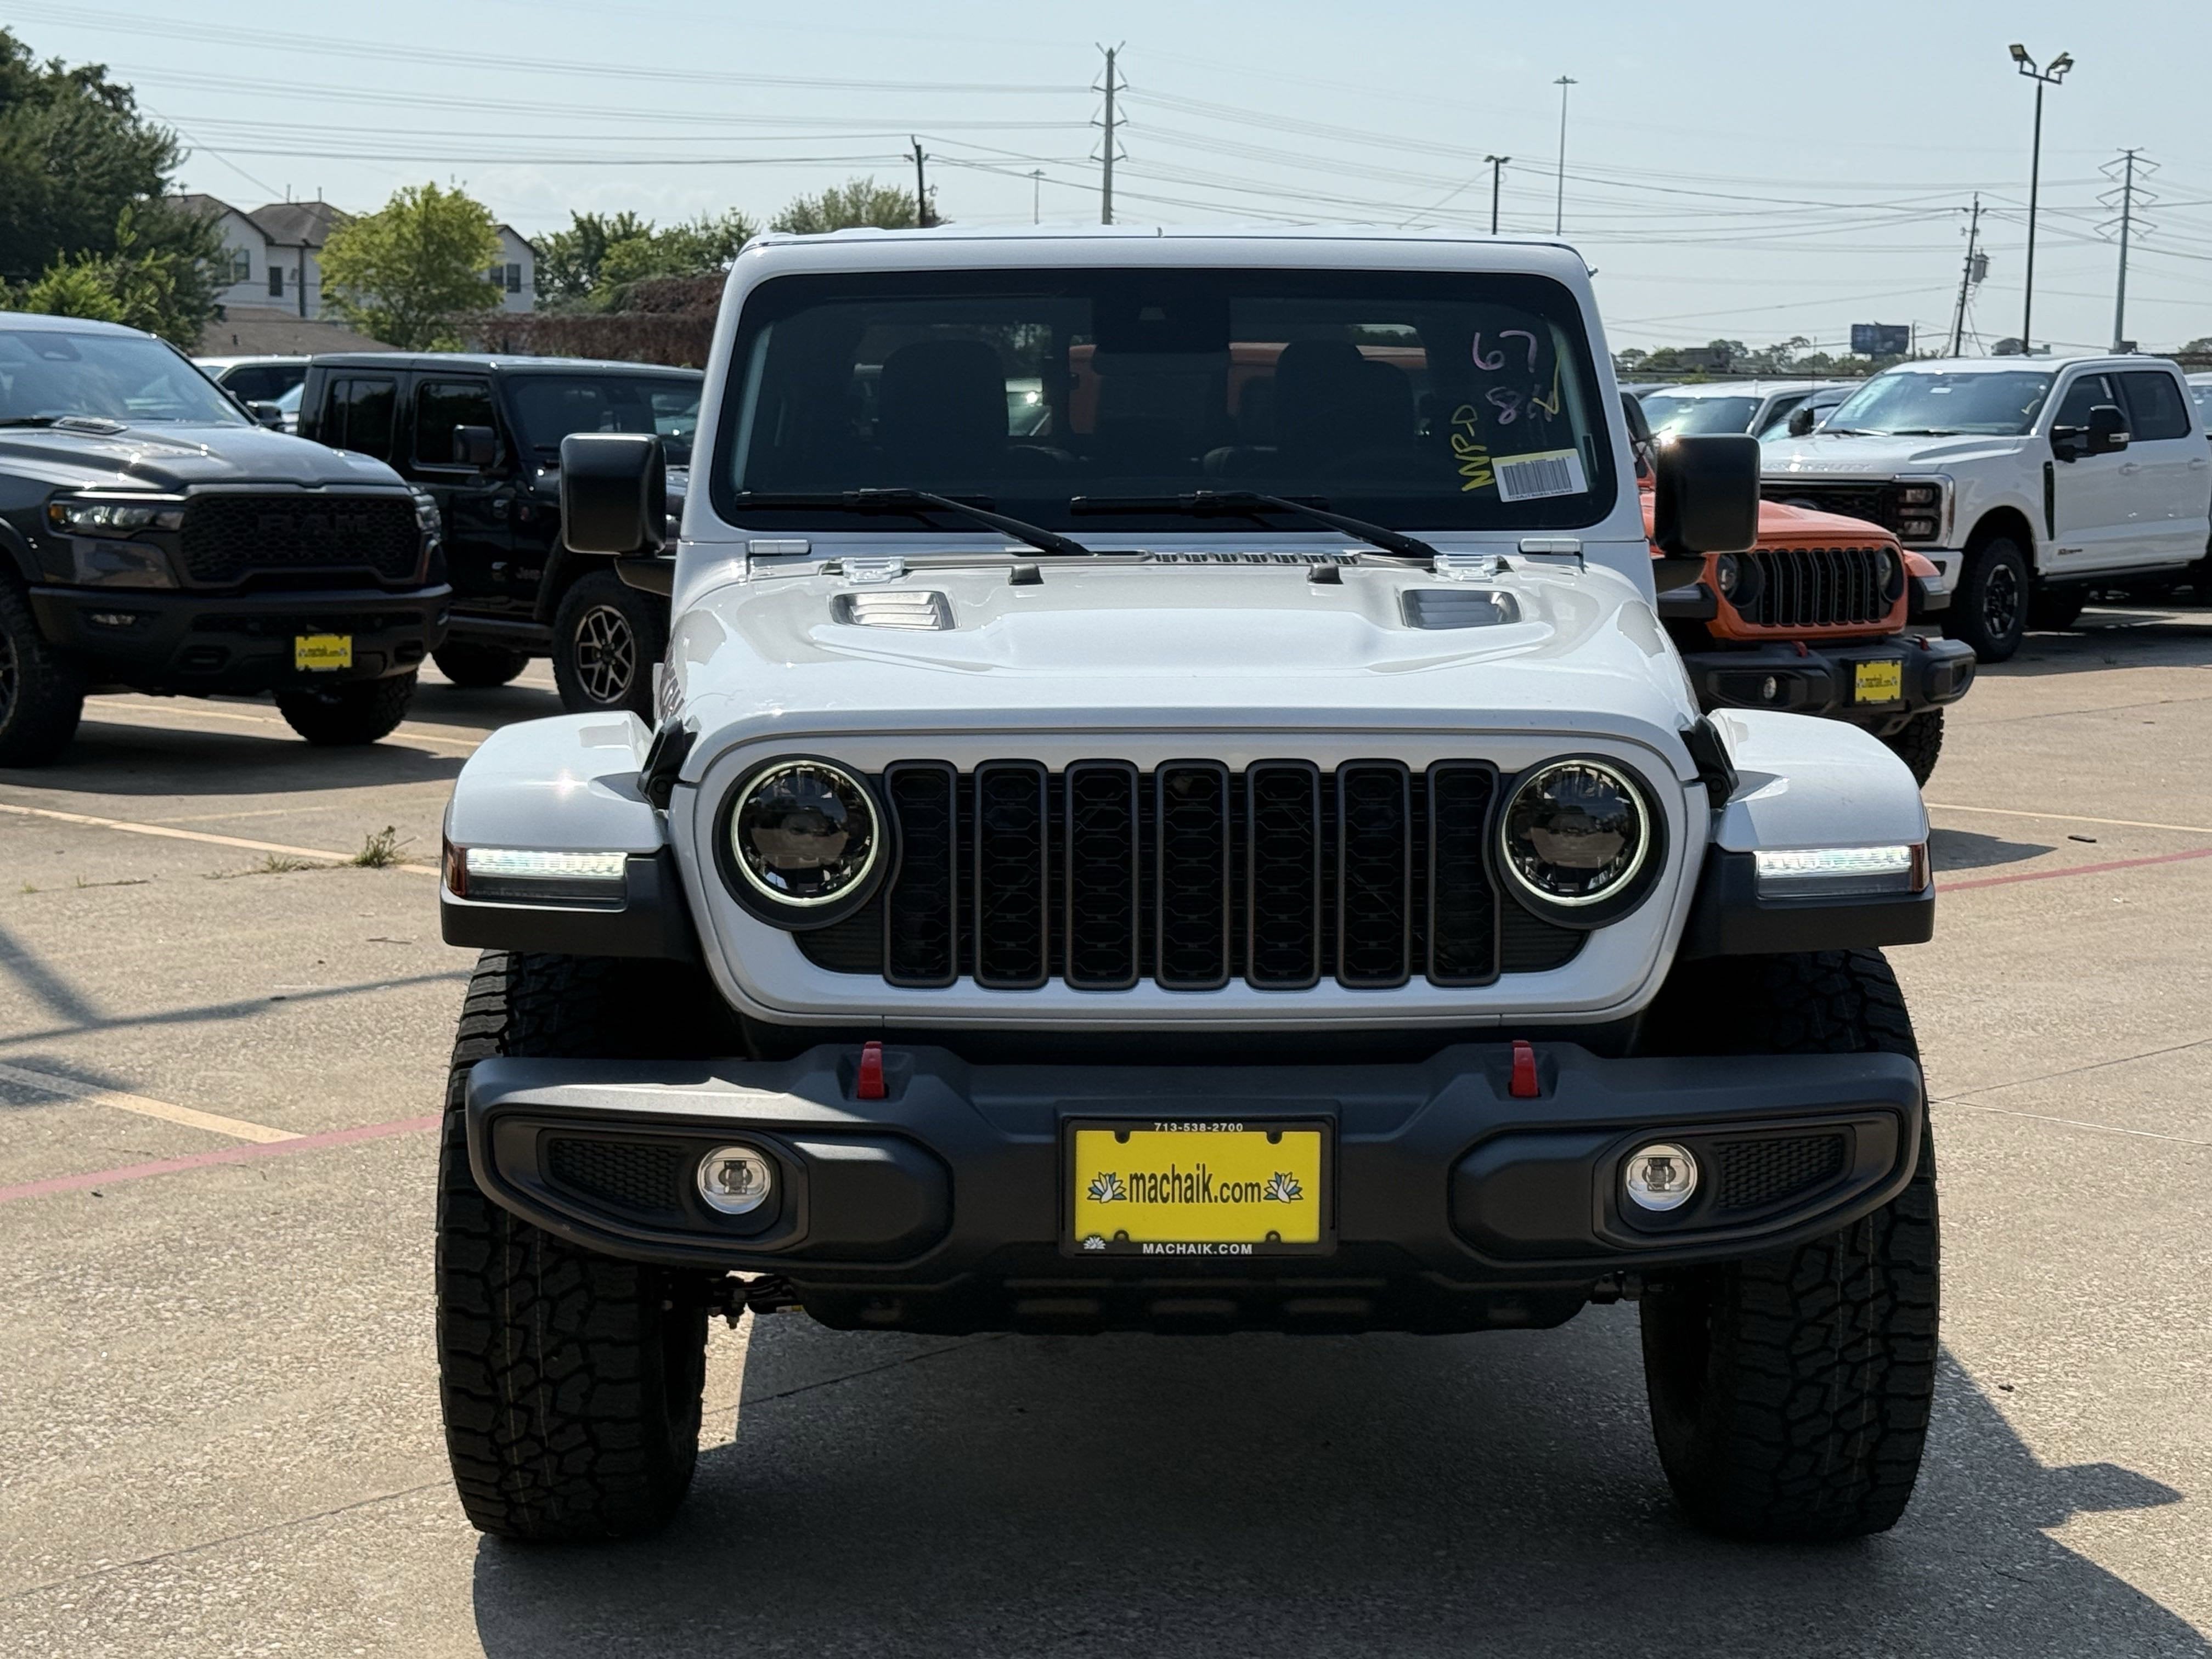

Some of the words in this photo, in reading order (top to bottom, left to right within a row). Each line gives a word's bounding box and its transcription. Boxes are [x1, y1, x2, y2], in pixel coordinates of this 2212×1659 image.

[1472, 330, 1537, 373] 67
[1154, 1122, 1244, 1132] 713-538-2700
[1128, 1164, 1262, 1203] machaik.com
[1142, 1243, 1253, 1255] MACHAIK.COM
